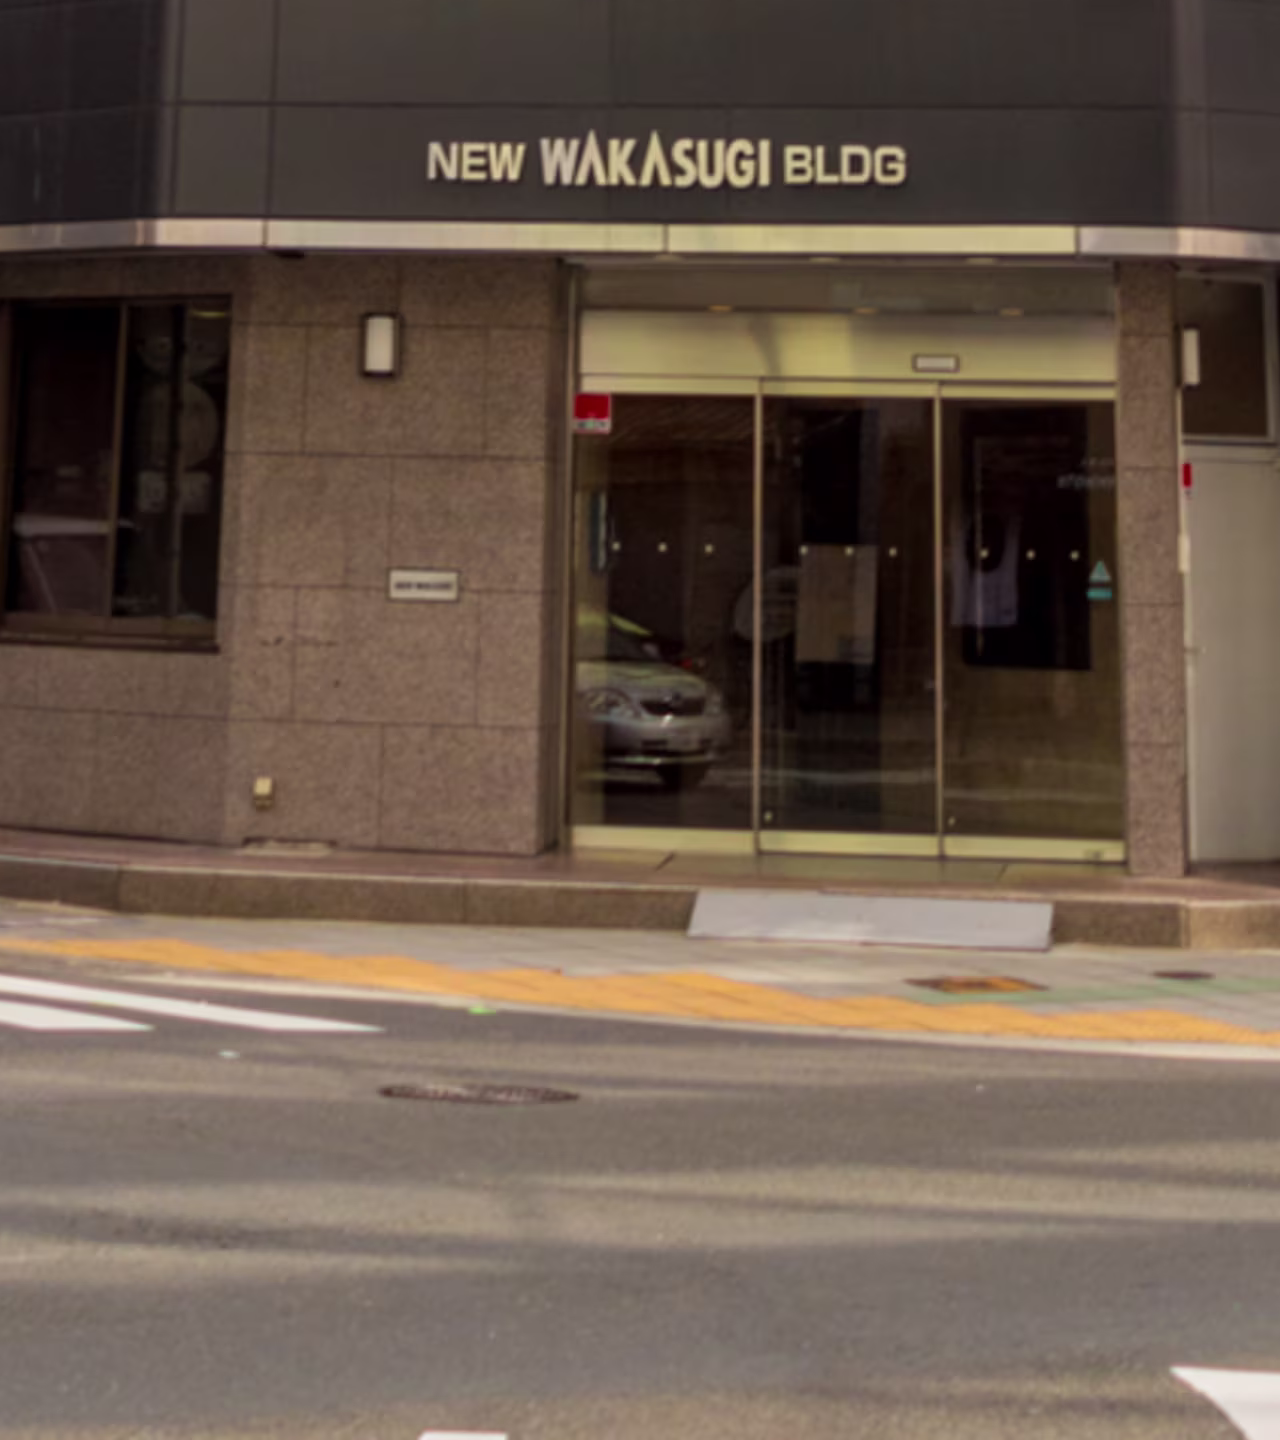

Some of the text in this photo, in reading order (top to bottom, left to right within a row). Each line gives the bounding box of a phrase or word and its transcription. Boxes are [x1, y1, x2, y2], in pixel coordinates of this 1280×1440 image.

[427, 129, 907, 188] NEW WAKASUGI BLDG
